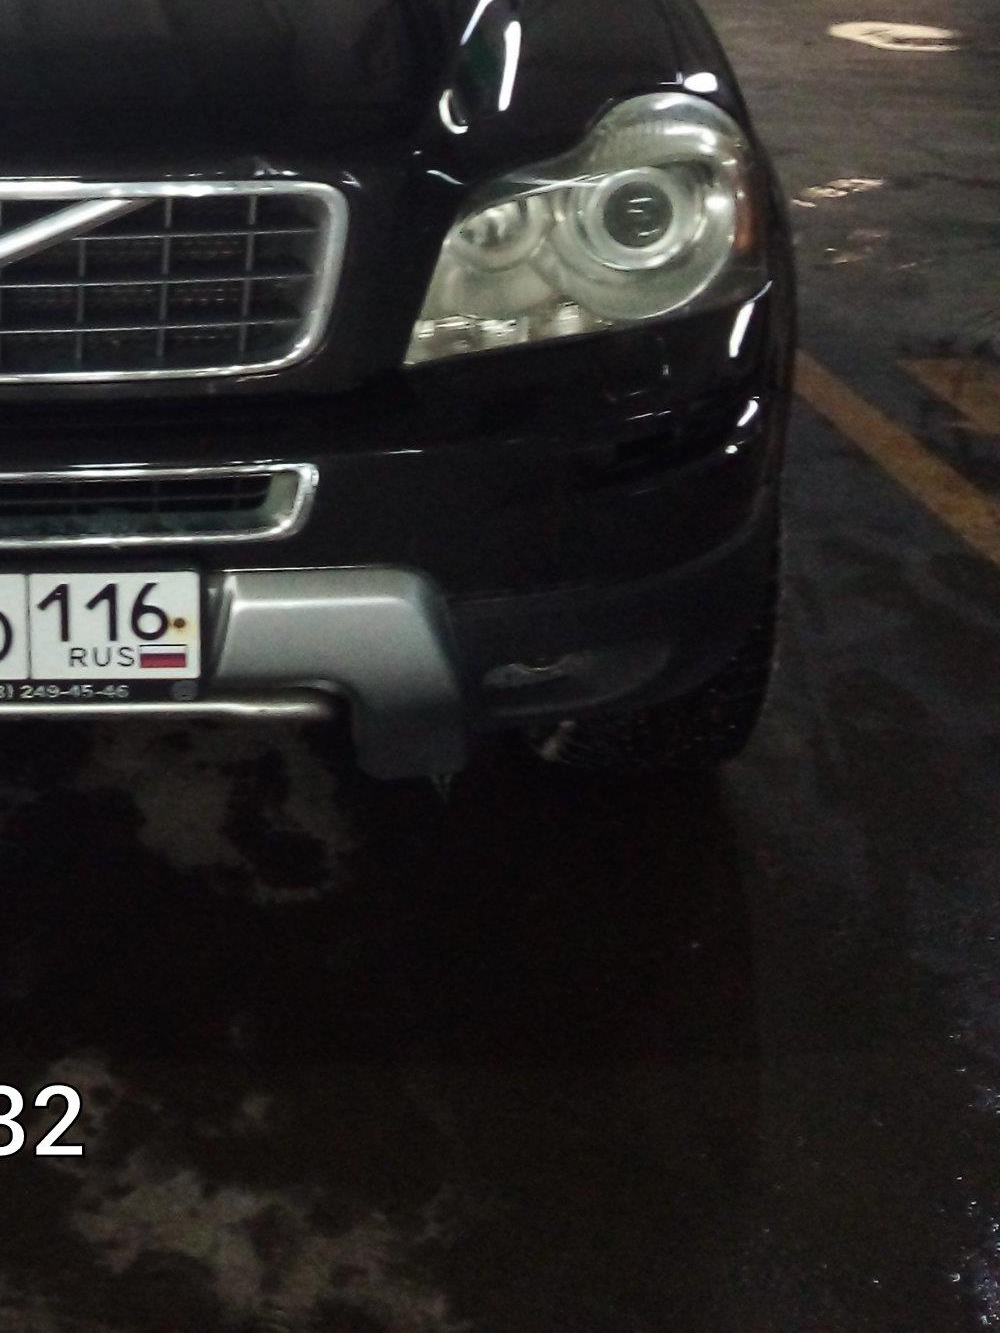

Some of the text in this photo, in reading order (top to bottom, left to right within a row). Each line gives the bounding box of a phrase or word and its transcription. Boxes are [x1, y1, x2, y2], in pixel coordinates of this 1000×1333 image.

[37, 582, 168, 643] 116
[69, 647, 135, 667] RUS
[20, 684, 130, 699] 249-45-46
